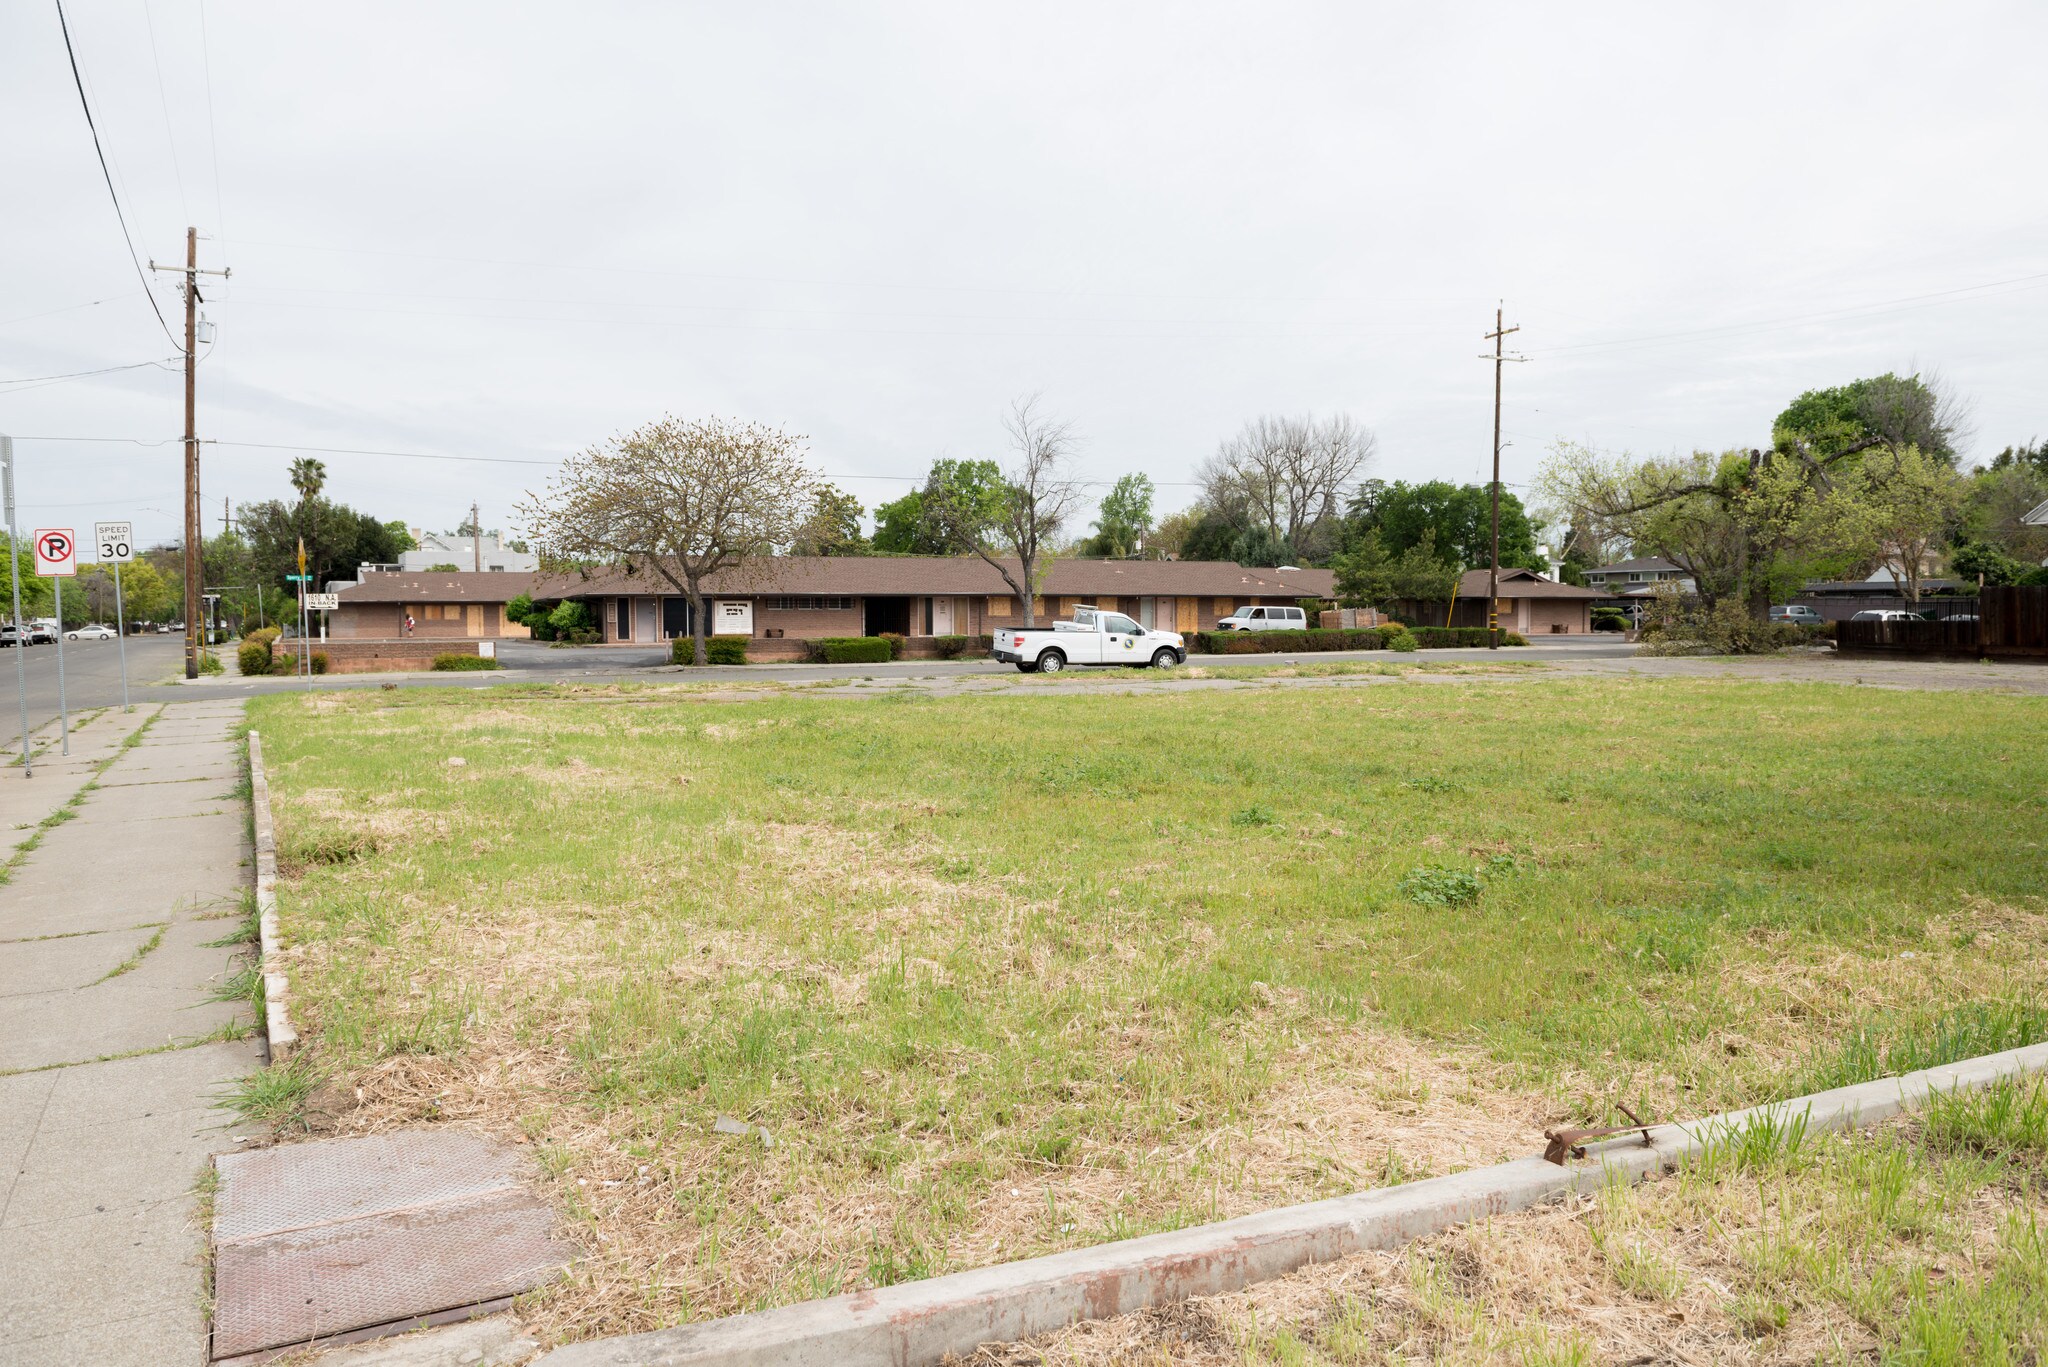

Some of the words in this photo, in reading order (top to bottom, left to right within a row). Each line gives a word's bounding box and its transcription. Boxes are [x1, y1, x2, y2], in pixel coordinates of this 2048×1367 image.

[99, 526, 128, 534] SPEED
[102, 534, 125, 542] LIMIT
[101, 543, 129, 558] 30
